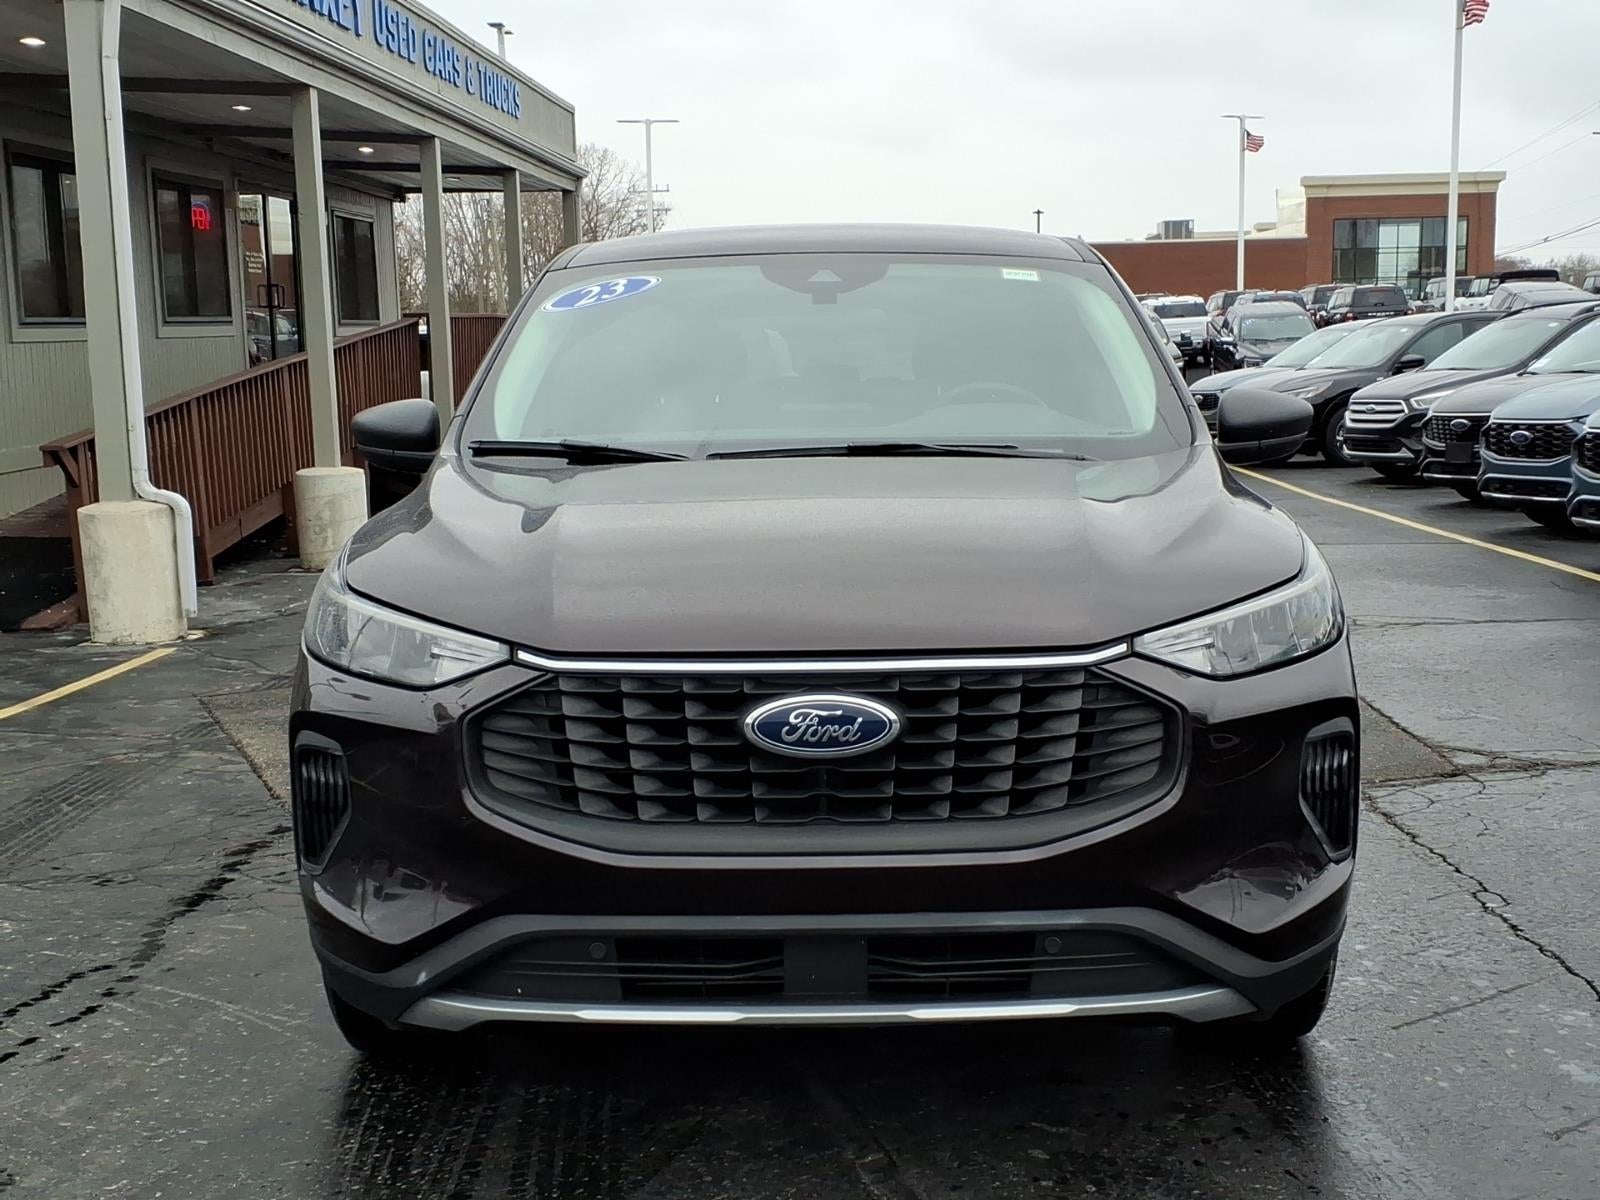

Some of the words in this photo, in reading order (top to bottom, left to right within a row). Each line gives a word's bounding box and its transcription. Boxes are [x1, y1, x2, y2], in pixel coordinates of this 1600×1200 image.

[372, 0, 417, 64] USED
[422, 29, 461, 88] CARS
[465, 56, 475, 95] &
[477, 61, 520, 119] TRUCKS
[574, 279, 628, 308] 23
[781, 708, 863, 743] Ford
